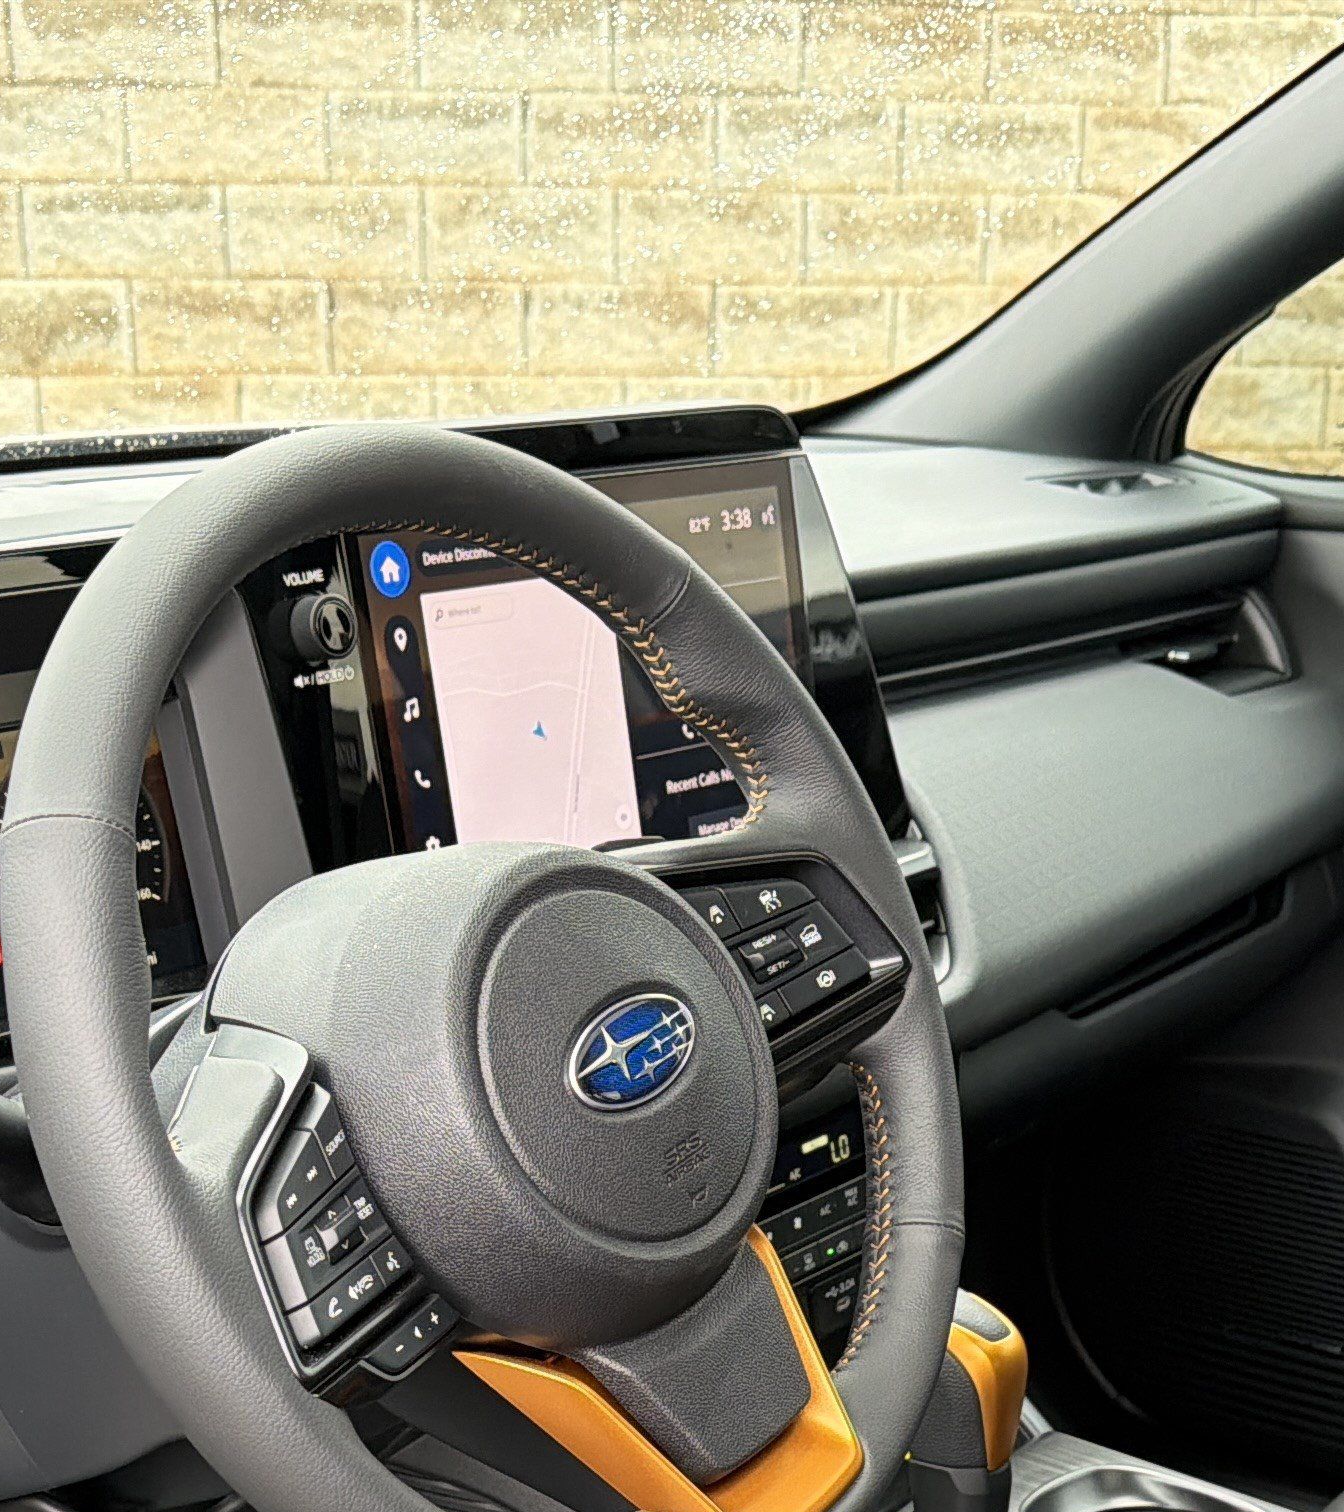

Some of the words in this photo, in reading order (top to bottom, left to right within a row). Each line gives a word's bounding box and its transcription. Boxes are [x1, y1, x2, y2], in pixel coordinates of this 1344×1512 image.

[720, 507, 753, 531] 3:38
[422, 551, 454, 567] Device
[282, 568, 325, 587] VOLUME
[666, 776, 698, 795] Recent
[698, 770, 720, 787] Calls
